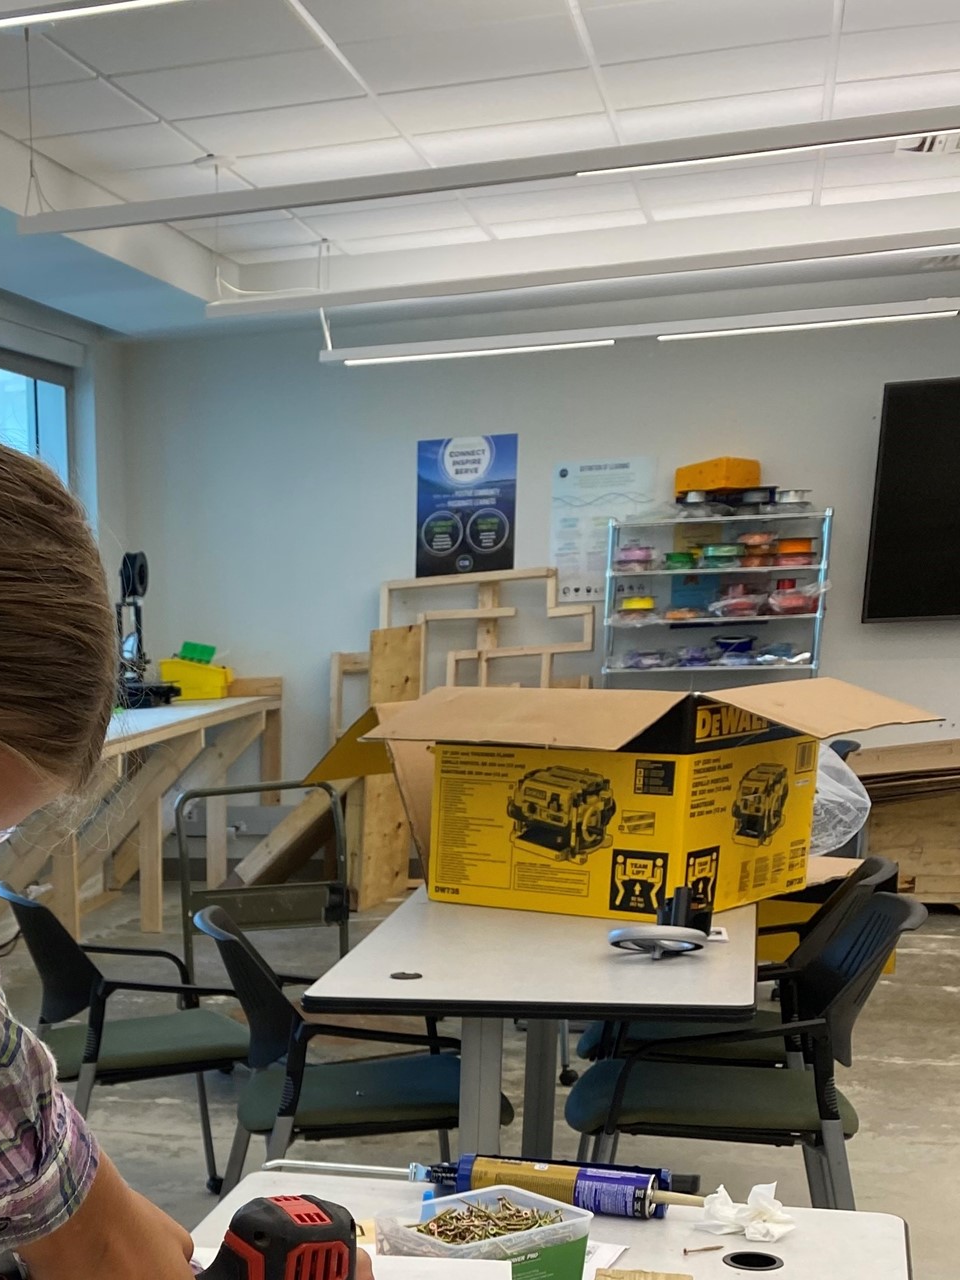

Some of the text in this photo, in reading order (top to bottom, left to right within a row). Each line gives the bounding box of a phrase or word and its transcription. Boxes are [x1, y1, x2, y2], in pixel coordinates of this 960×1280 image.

[449, 449, 486, 458] CONNECT
[452, 458, 481, 466] INSPIRE
[455, 467, 478, 475] SERVE
[696, 705, 769, 738] DEWAL
[527, 1252, 539, 1260] PRO
